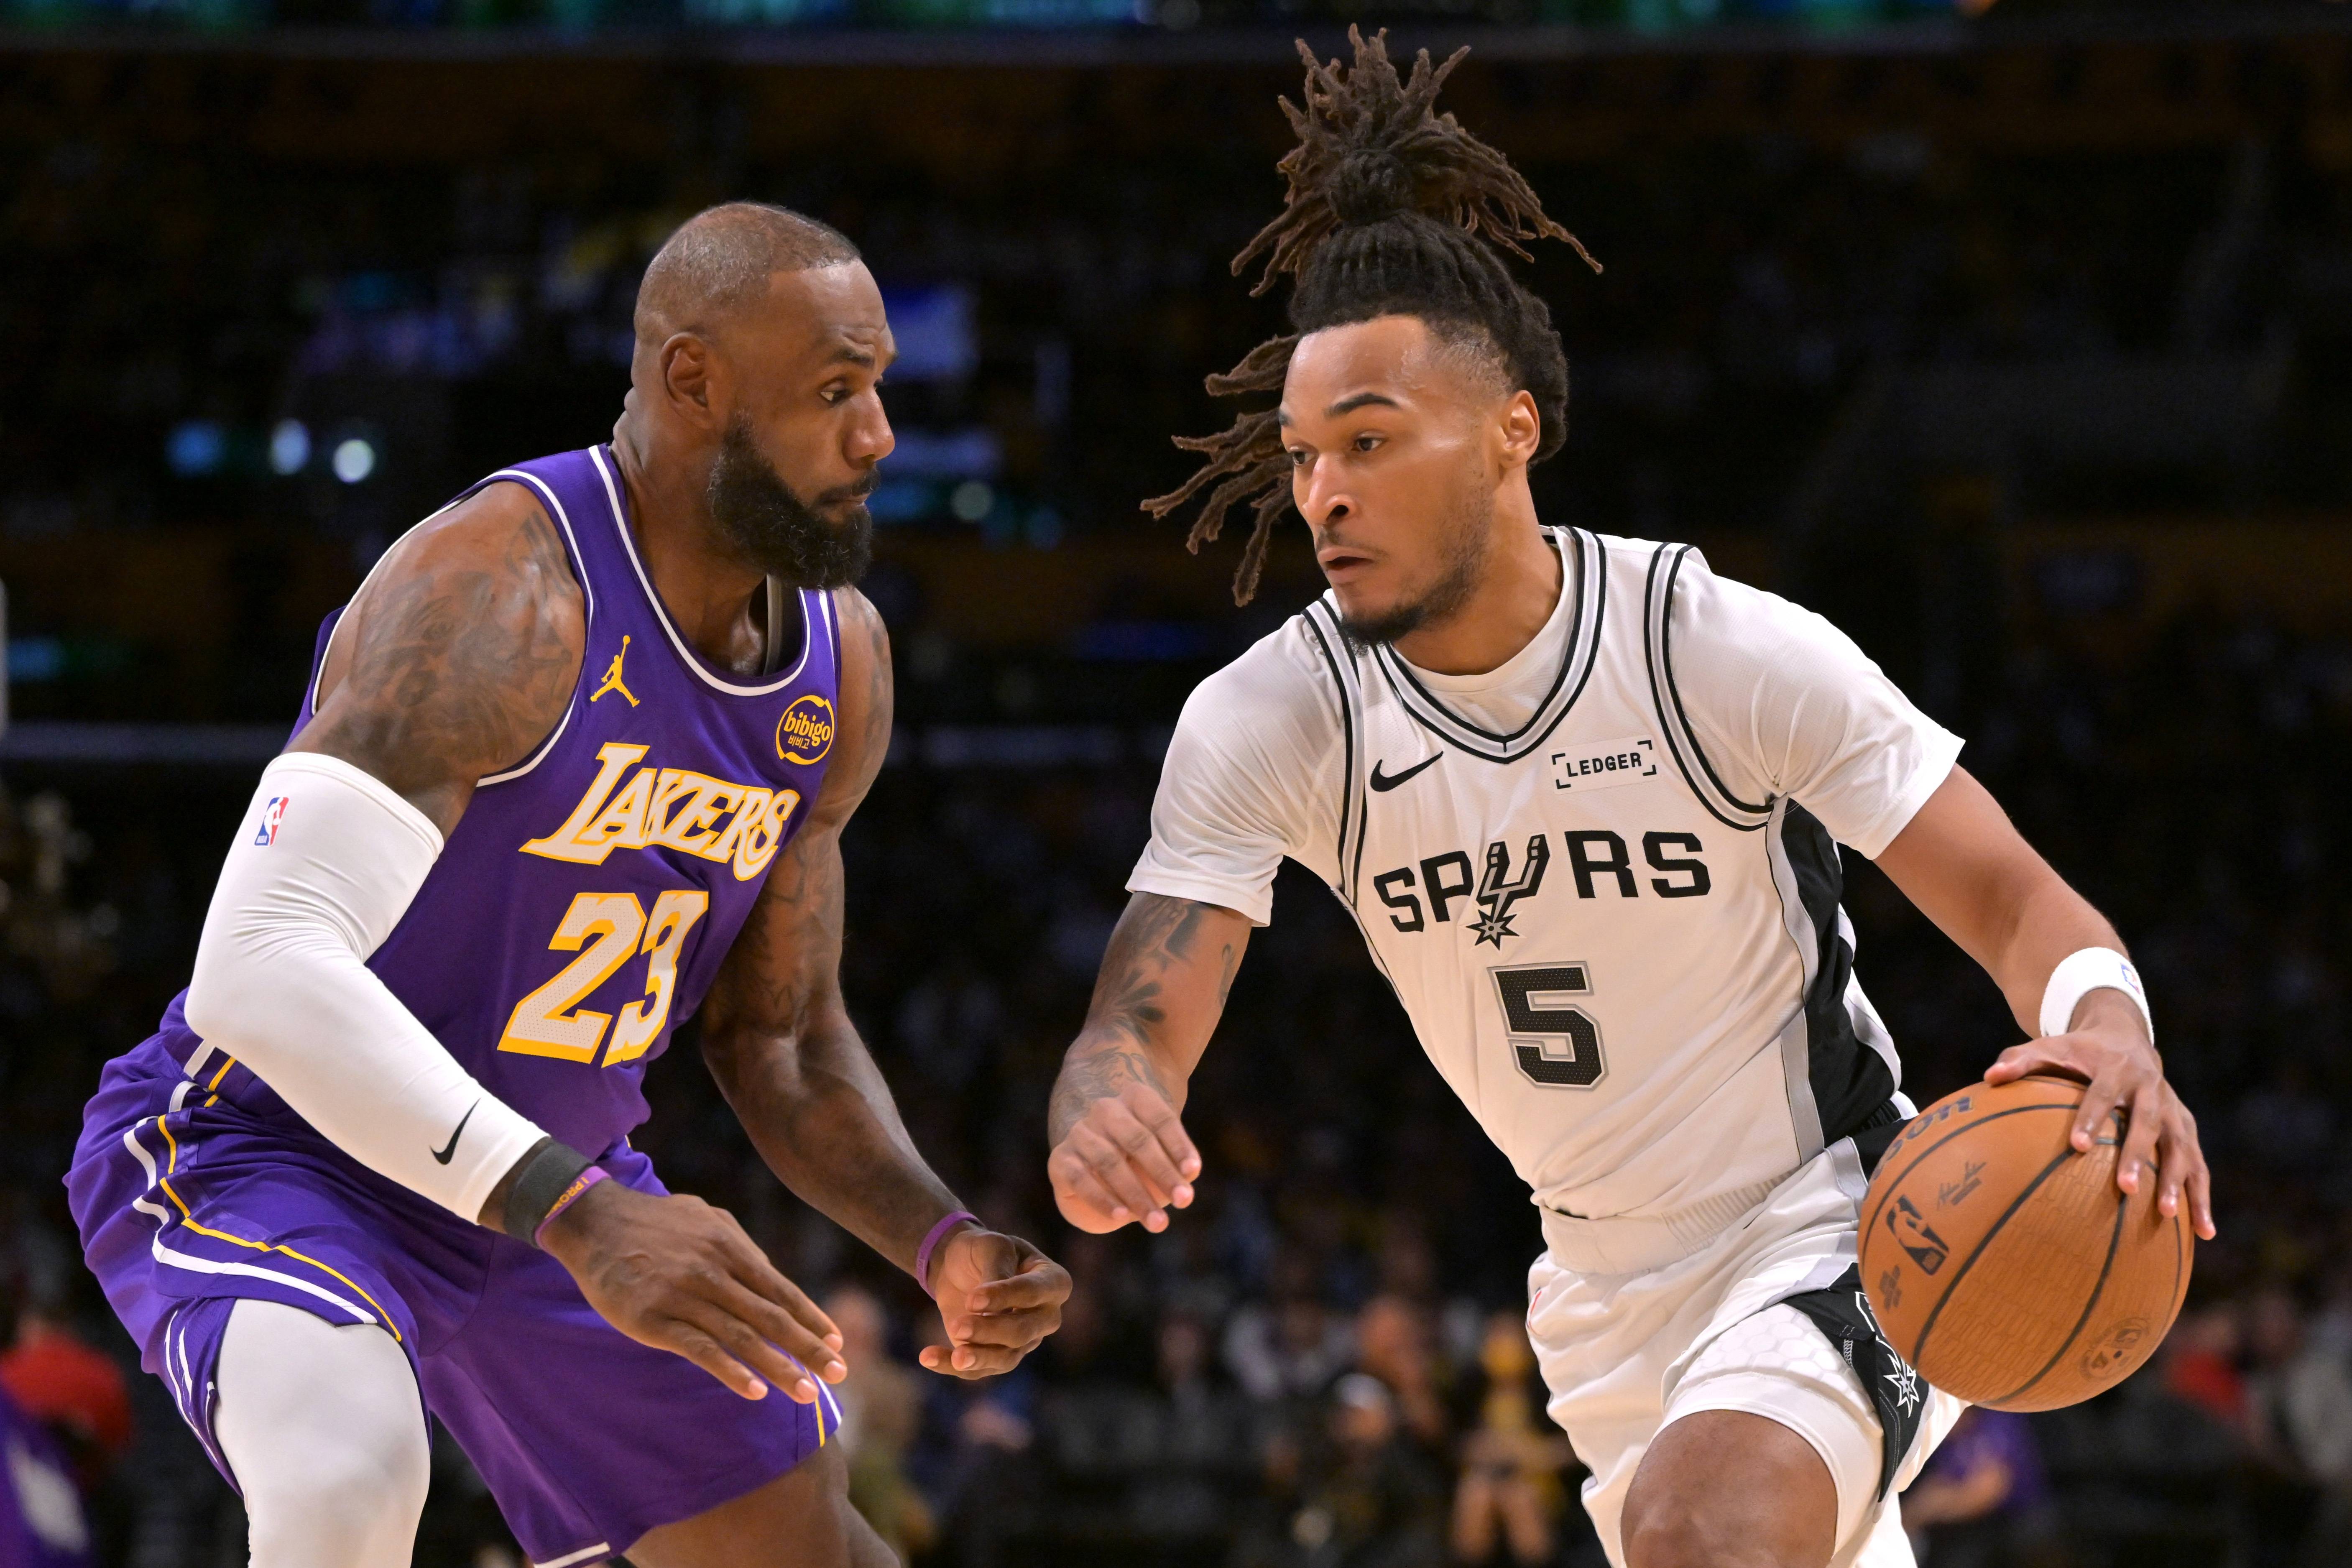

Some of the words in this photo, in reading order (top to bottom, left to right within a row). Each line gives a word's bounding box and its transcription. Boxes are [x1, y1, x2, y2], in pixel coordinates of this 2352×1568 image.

[784, 711, 831, 747] bibigo
[787, 735, 810, 749] 비비고
[1566, 752, 1642, 777] LEDGER
[518, 742, 800, 881] LAKERS
[1373, 830, 1711, 951] SPURS
[497, 890, 709, 1067] 23
[1487, 961, 1609, 1091] 5
